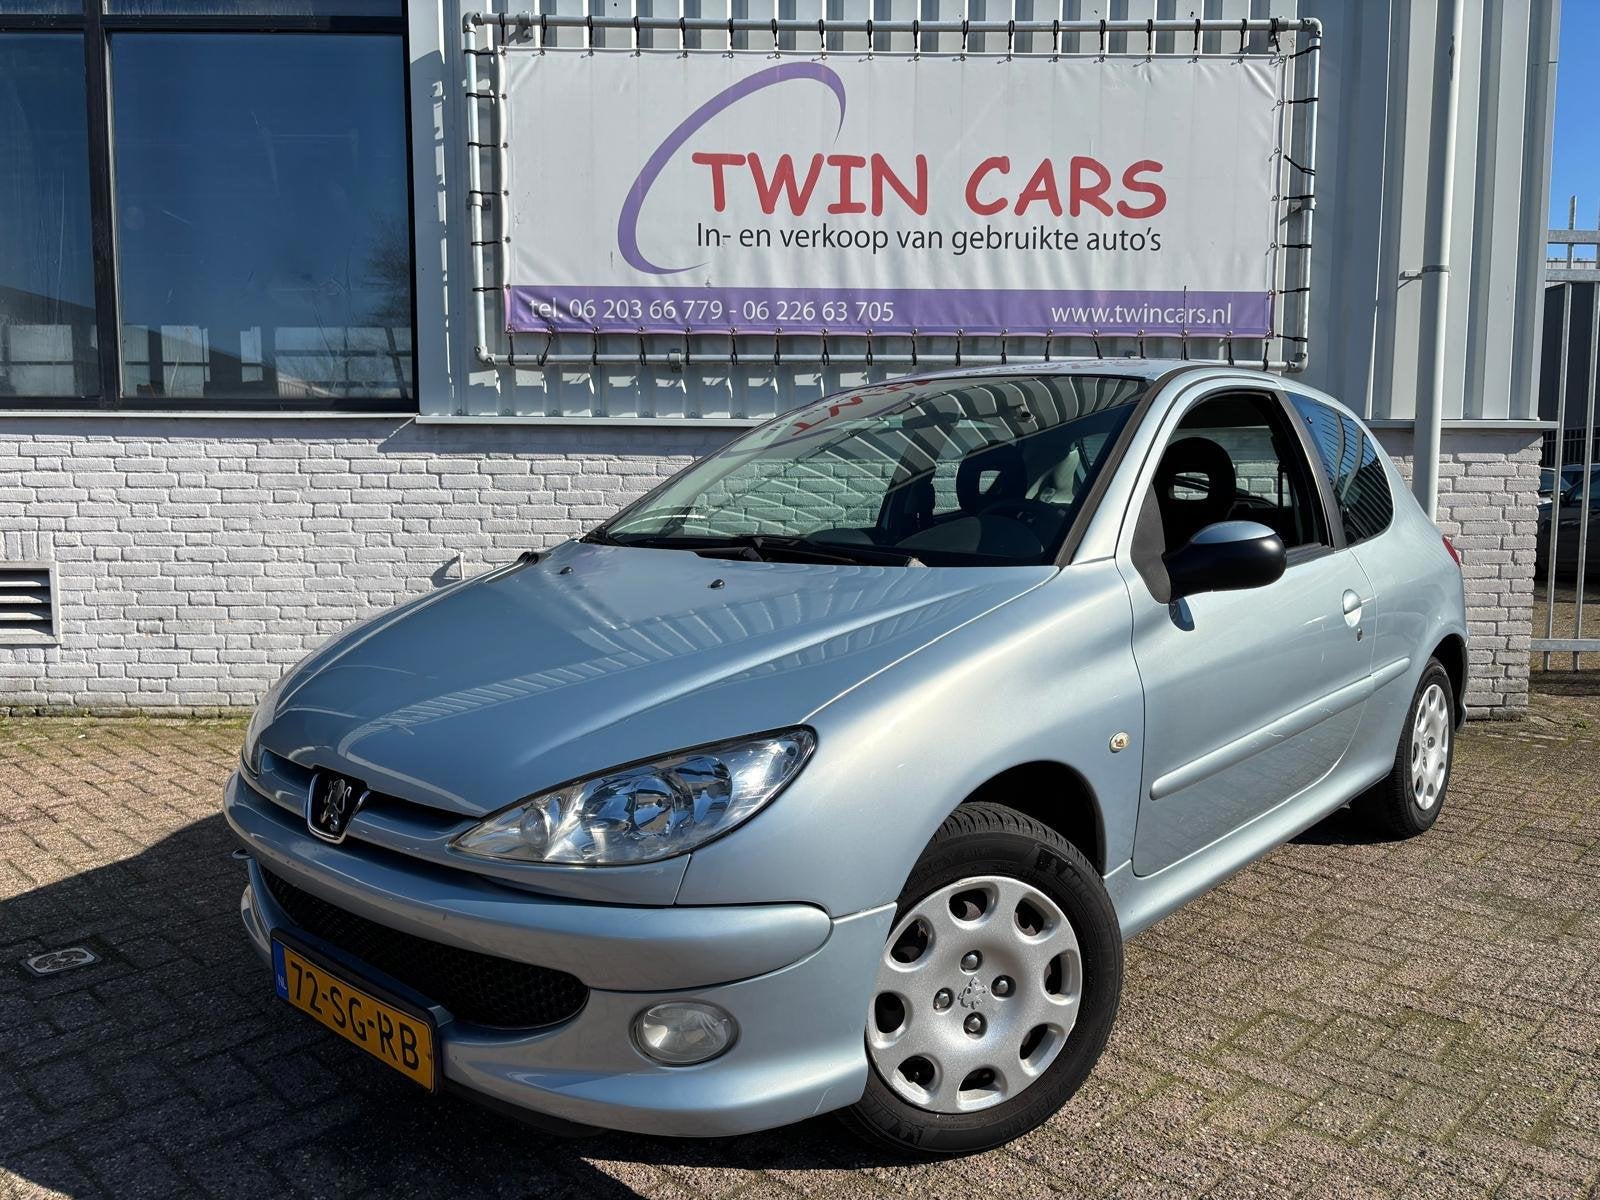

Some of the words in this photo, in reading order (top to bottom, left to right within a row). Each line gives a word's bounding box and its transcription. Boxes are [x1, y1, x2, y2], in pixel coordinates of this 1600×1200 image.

[691, 152, 928, 217] TWIN
[965, 155, 1167, 219] CARS
[697, 222, 732, 247] In-
[739, 228, 771, 247] en
[780, 222, 889, 255] verkoop
[897, 230, 943, 249] van
[951, 224, 1079, 256] gebruikte
[1086, 227, 1161, 251] auto's
[529, 297, 563, 319] tel.
[569, 299, 597, 319] 06
[603, 299, 643, 320] 203
[649, 299, 677, 320] 66
[683, 300, 723, 320] 779
[743, 300, 770, 321] 06
[776, 300, 816, 322] 226
[821, 301, 849, 322] 63
[855, 301, 894, 322] 705
[1051, 302, 1232, 324] www.twincars.nl
[290, 960, 419, 1070] 72-SG-RB
